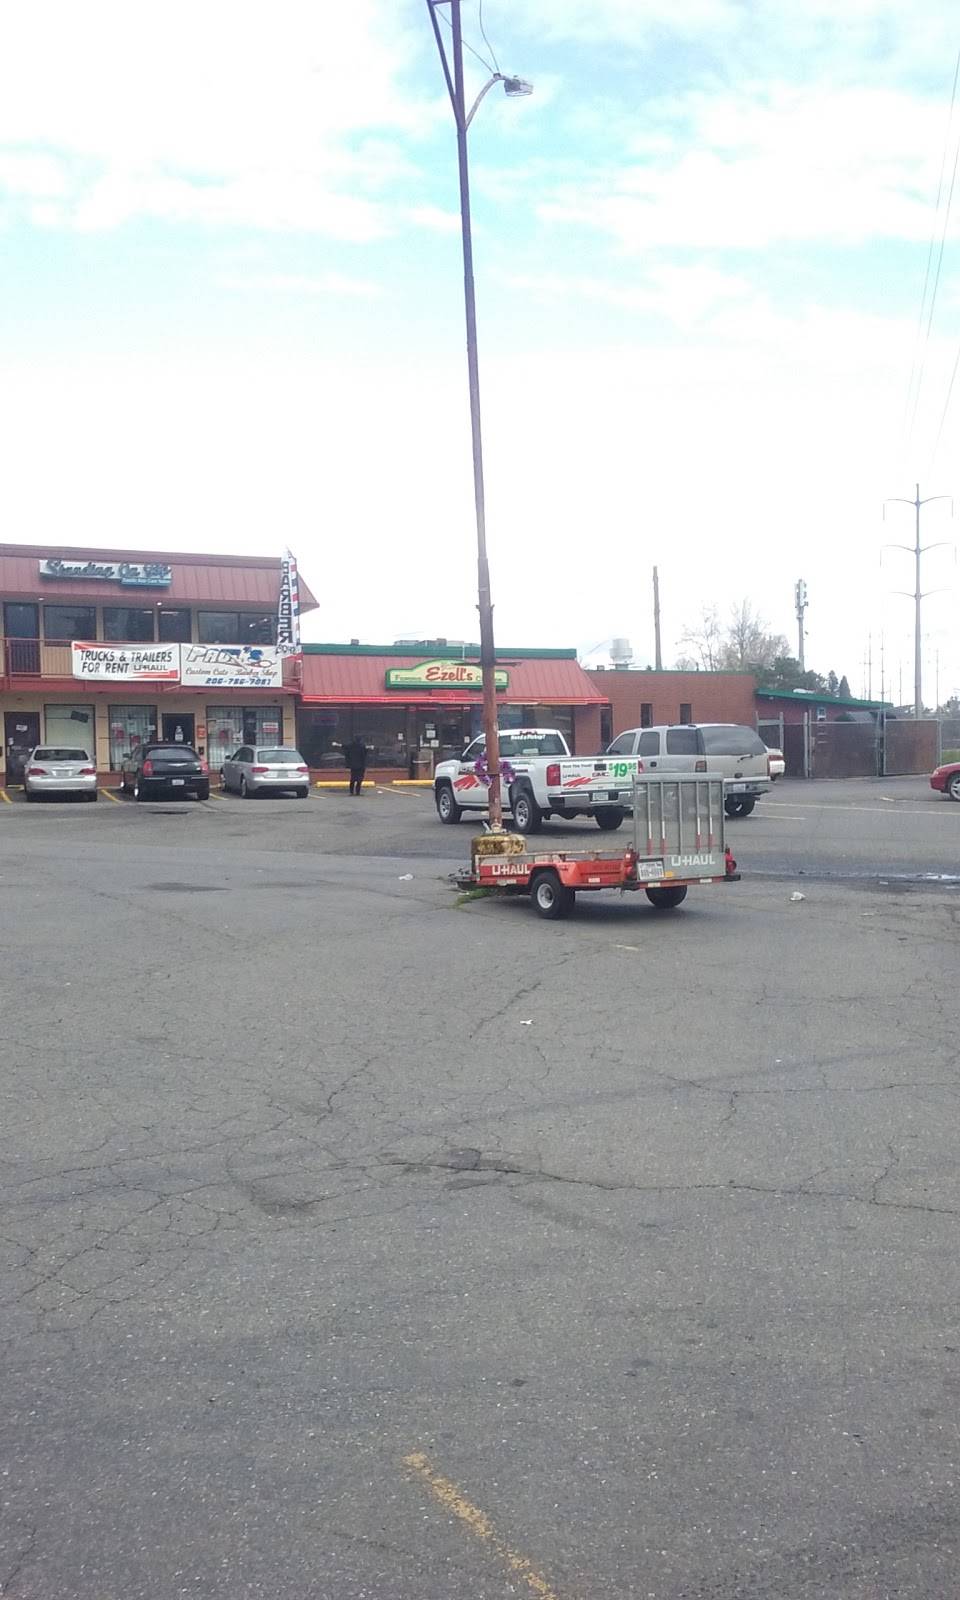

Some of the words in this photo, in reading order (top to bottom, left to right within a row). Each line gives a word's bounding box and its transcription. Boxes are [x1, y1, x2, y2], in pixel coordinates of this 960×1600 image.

[80, 651, 115, 661] TRUCKS
[118, 652, 126, 661] &
[130, 652, 173, 663] TRAILERS
[81, 662, 101, 672] FOR
[104, 663, 130, 673] RENT
[426, 665, 474, 681] Ezell's
[671, 854, 716, 866] U-HAUL
[492, 864, 530, 875] U-HAUL
